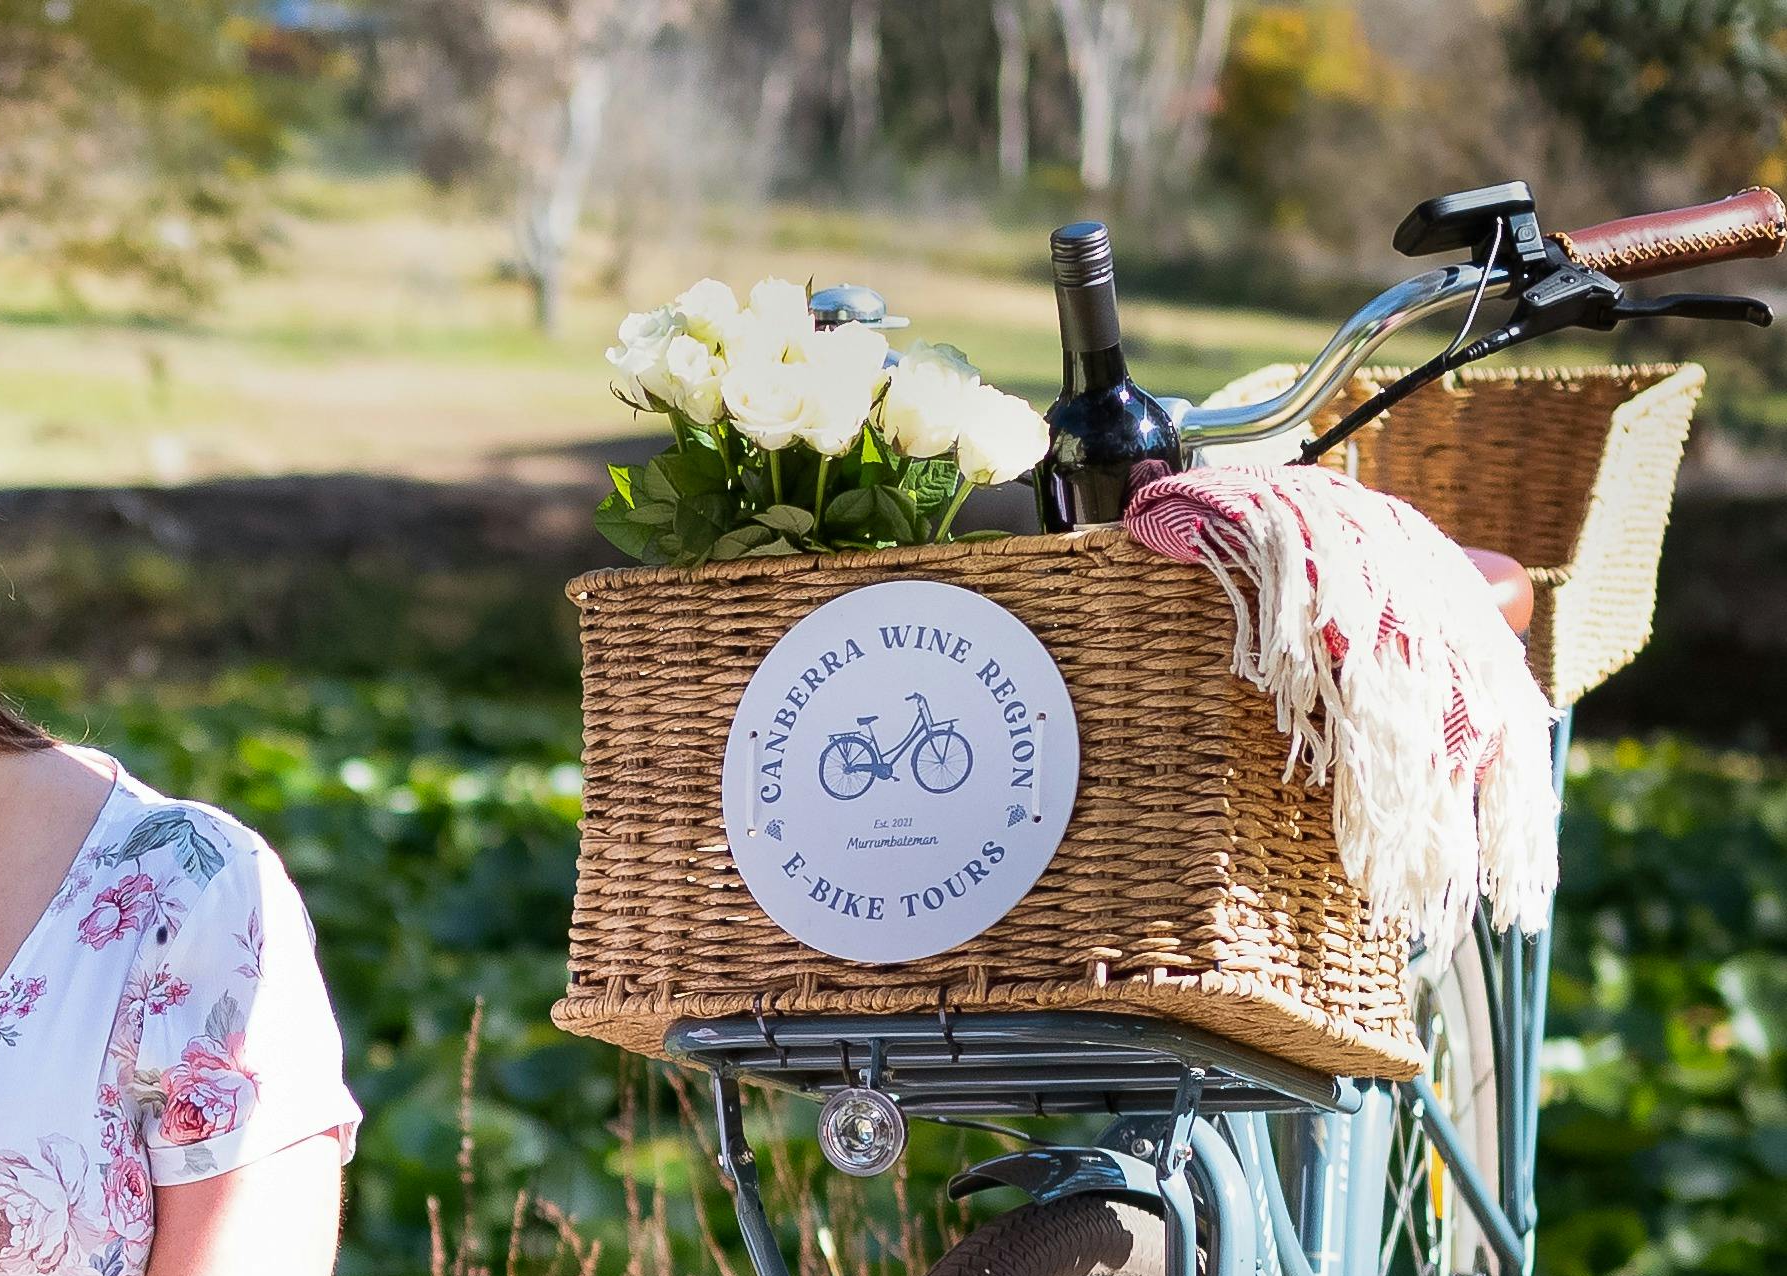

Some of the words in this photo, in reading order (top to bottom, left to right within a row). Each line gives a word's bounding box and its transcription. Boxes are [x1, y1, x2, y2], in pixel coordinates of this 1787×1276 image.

[760, 637, 866, 804] CANBERRA
[878, 624, 973, 664] WINE
[975, 658, 1035, 789] REGION
[846, 835, 939, 850] Murrumbateman
[892, 817, 914, 828] 2021
[781, 851, 885, 921] E-BIKE
[899, 840, 1006, 918] TOURS
